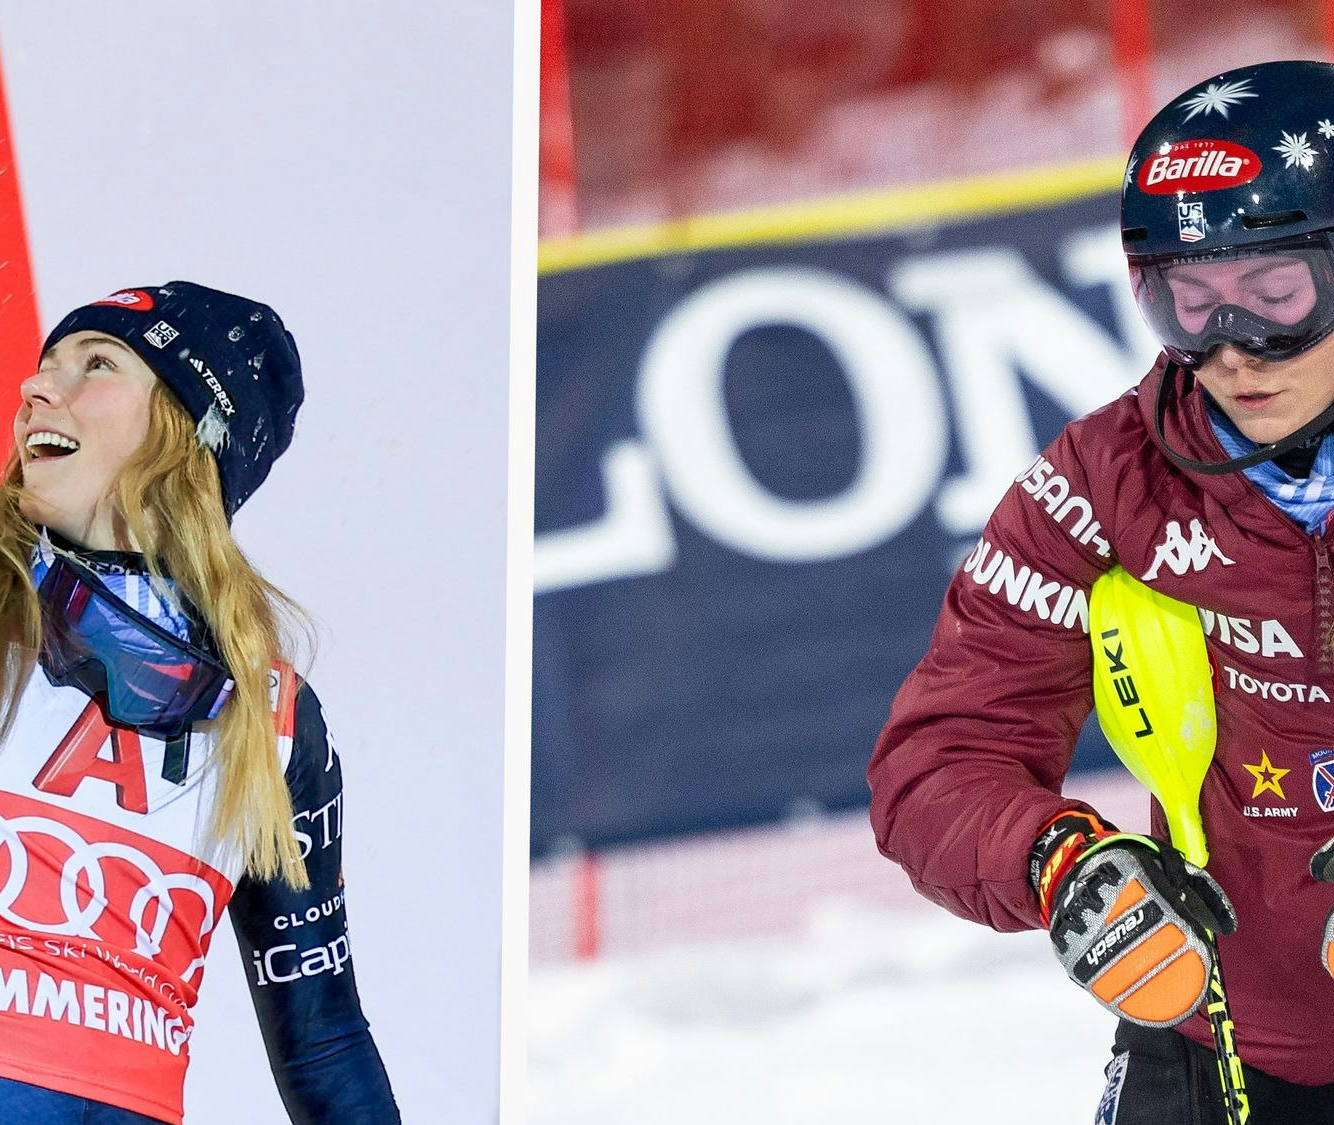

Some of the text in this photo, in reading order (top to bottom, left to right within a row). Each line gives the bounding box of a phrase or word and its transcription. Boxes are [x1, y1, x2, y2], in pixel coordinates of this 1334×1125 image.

[1146, 151, 1243, 186] Barilla
[158, 322, 176, 338] US
[202, 368, 236, 416] TERREX
[1196, 607, 1304, 659] VISA
[1102, 627, 1154, 739] LEKI
[1224, 666, 1330, 703] TOYOTA
[1243, 806, 1299, 817] U.S. ARMY
[273, 893, 346, 930] CLOUD
[44, 939, 87, 959] Ski
[1086, 908, 1146, 966] reusch
